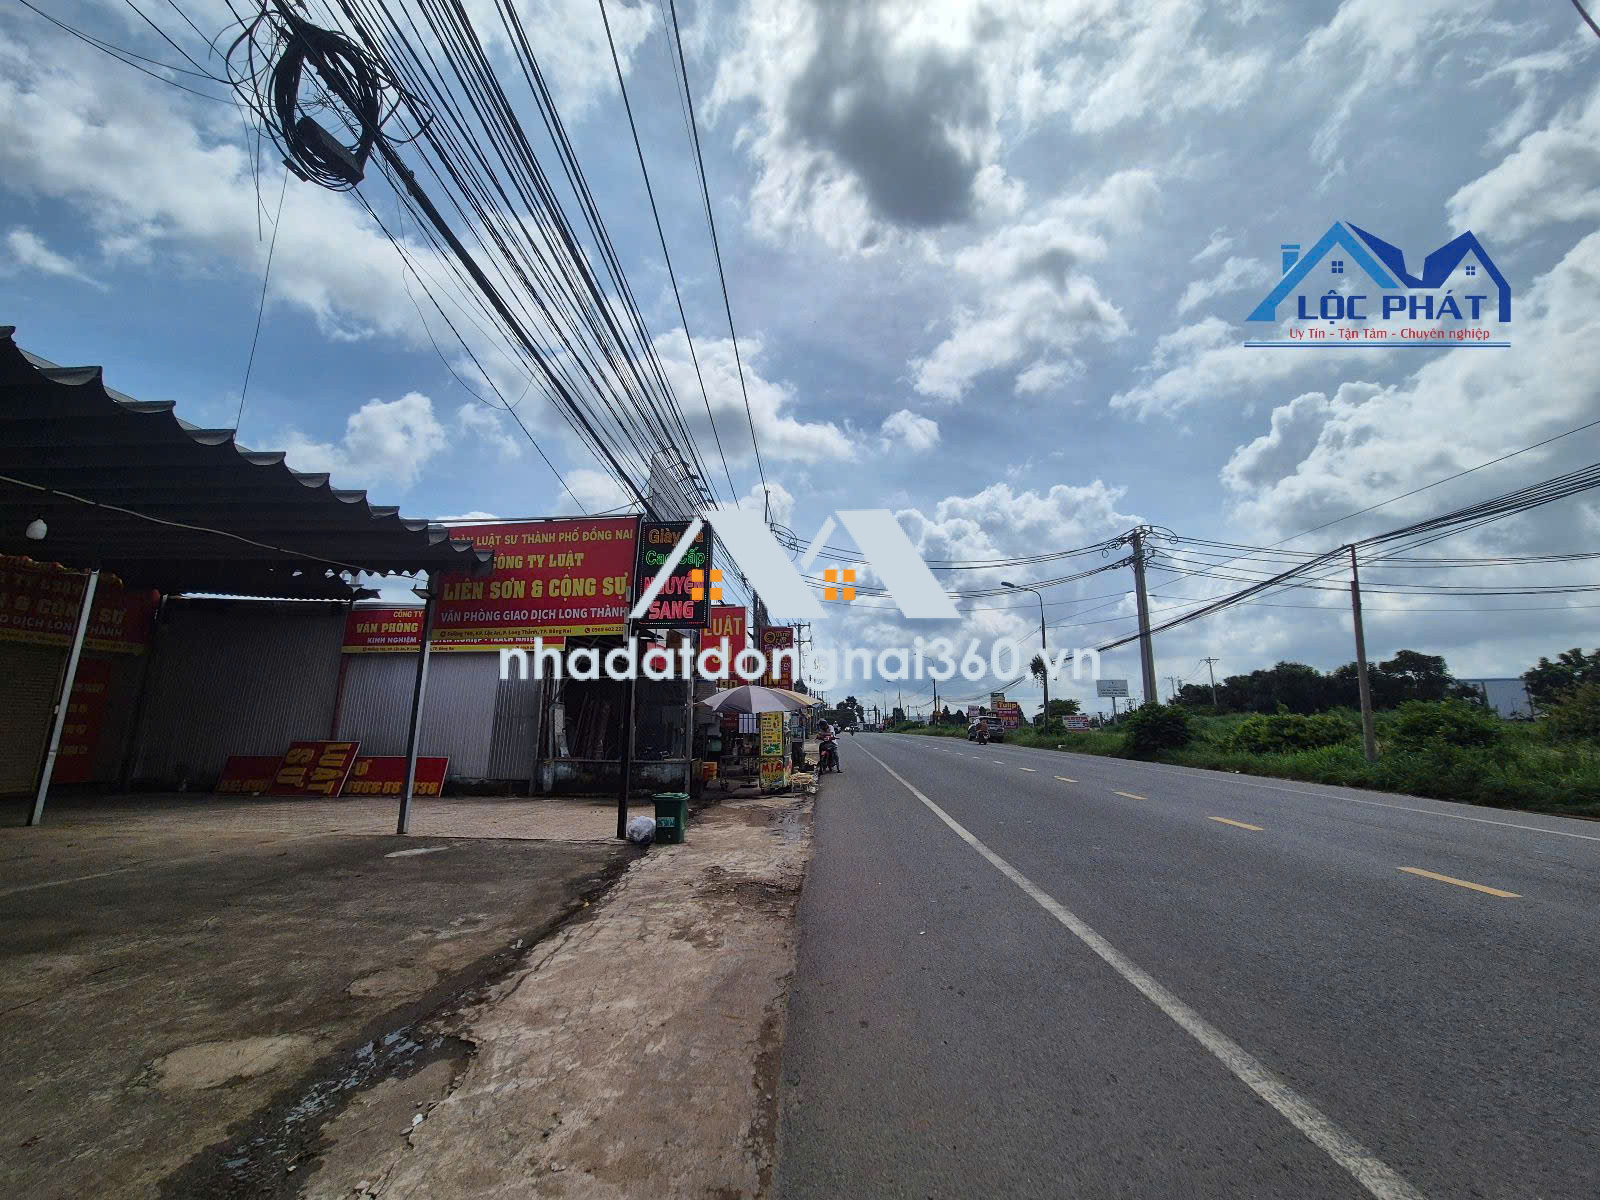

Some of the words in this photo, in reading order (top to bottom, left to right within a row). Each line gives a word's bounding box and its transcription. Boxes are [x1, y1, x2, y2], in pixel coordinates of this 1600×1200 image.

[476, 534, 502, 547] LUẬT
[504, 534, 519, 545] SƯ
[522, 531, 556, 544] THÀNH
[558, 526, 580, 542] PHỐ
[582, 527, 612, 541] ĐỒNG
[615, 529, 633, 540] NAI
[493, 552, 523, 569] ÔNG
[528, 554, 546, 568] TY
[549, 550, 585, 570] LUẬT
[443, 577, 483, 600] LIÊN
[489, 577, 526, 599] SƠN
[531, 579, 544, 598] &
[549, 573, 597, 602] CỘNG
[602, 572, 629, 600] SỰ
[393, 609, 412, 618] CÔNG
[441, 609, 461, 622] VĂN
[463, 608, 501, 622] PHÒNG
[503, 610, 529, 621] GIAO
[530, 609, 555, 623] DỊCH
[558, 607, 588, 619] LONG
[591, 605, 628, 618] THÀNH
[649, 600, 694, 619] SANG
[356, 620, 379, 633] VĂN
[381, 620, 418, 633] PHÒNG
[367, 636, 386, 644] KINH
[387, 635, 417, 644] NGHIỆM
